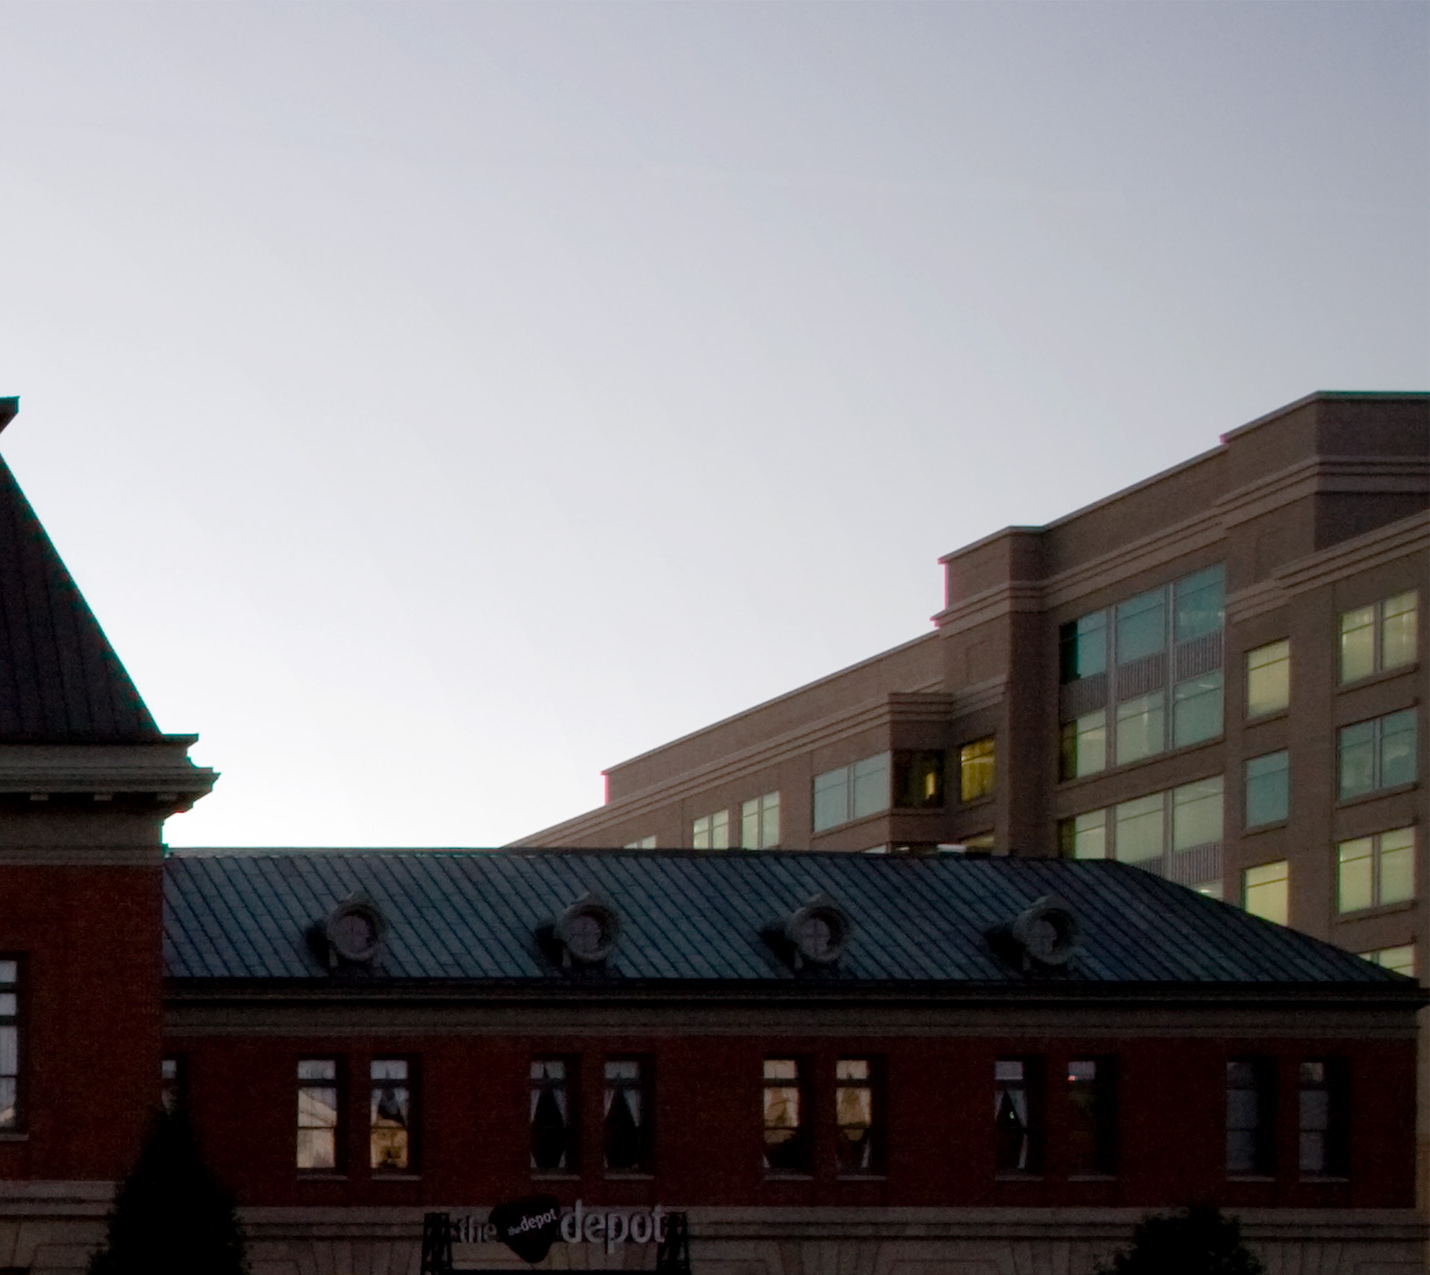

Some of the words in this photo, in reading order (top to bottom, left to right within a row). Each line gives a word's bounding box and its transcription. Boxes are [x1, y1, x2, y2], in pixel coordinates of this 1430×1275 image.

[458, 1215, 498, 1244] the
[559, 1199, 667, 1255] depot
[520, 1207, 559, 1232] depot
